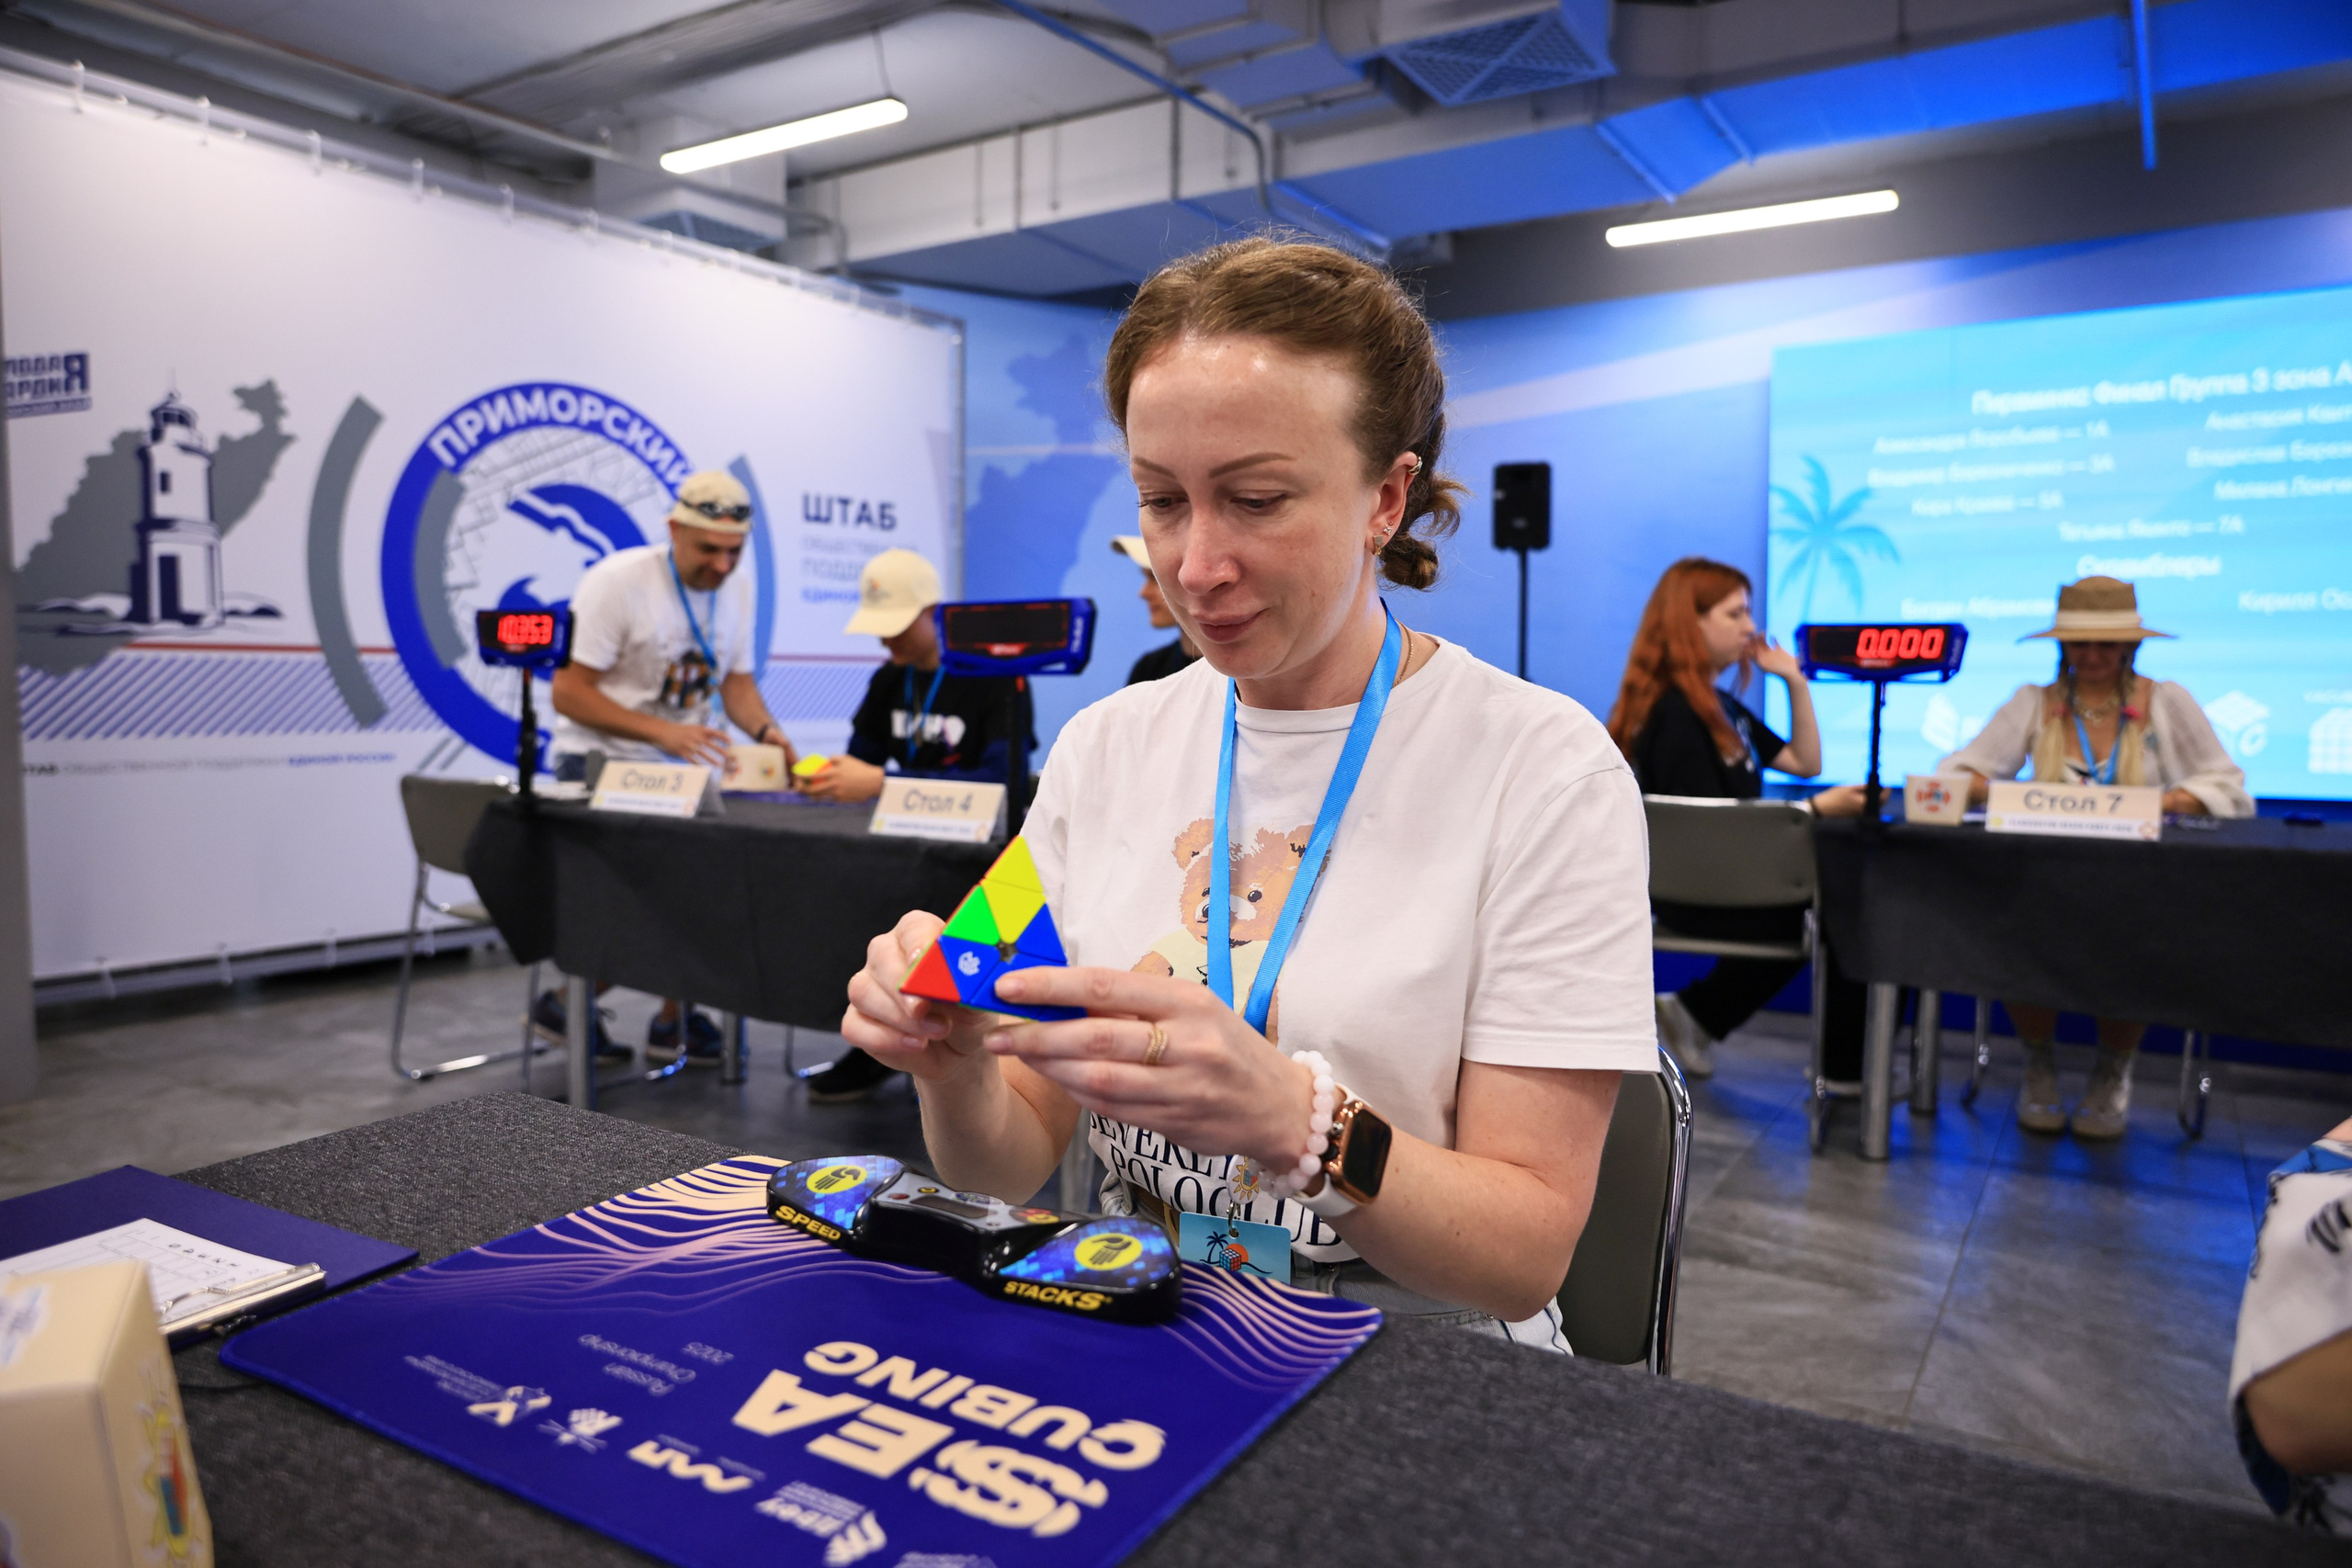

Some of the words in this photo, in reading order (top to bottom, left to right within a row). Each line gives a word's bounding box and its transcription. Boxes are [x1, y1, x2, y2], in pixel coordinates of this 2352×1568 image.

[2274, 367, 2331, 390] зона
[801, 493, 898, 533] ШТАБ
[621, 768, 667, 791] Стол
[902, 787, 955, 813] Стол
[958, 792, 975, 813] 4
[2024, 788, 2097, 814] Стол
[2107, 793, 2124, 814] 7
[775, 1205, 842, 1241] SPEED
[1003, 1280, 1105, 1311] STACKS
[602, 1361, 676, 1398] Russian
[803, 1340, 1168, 1472] CUBING
